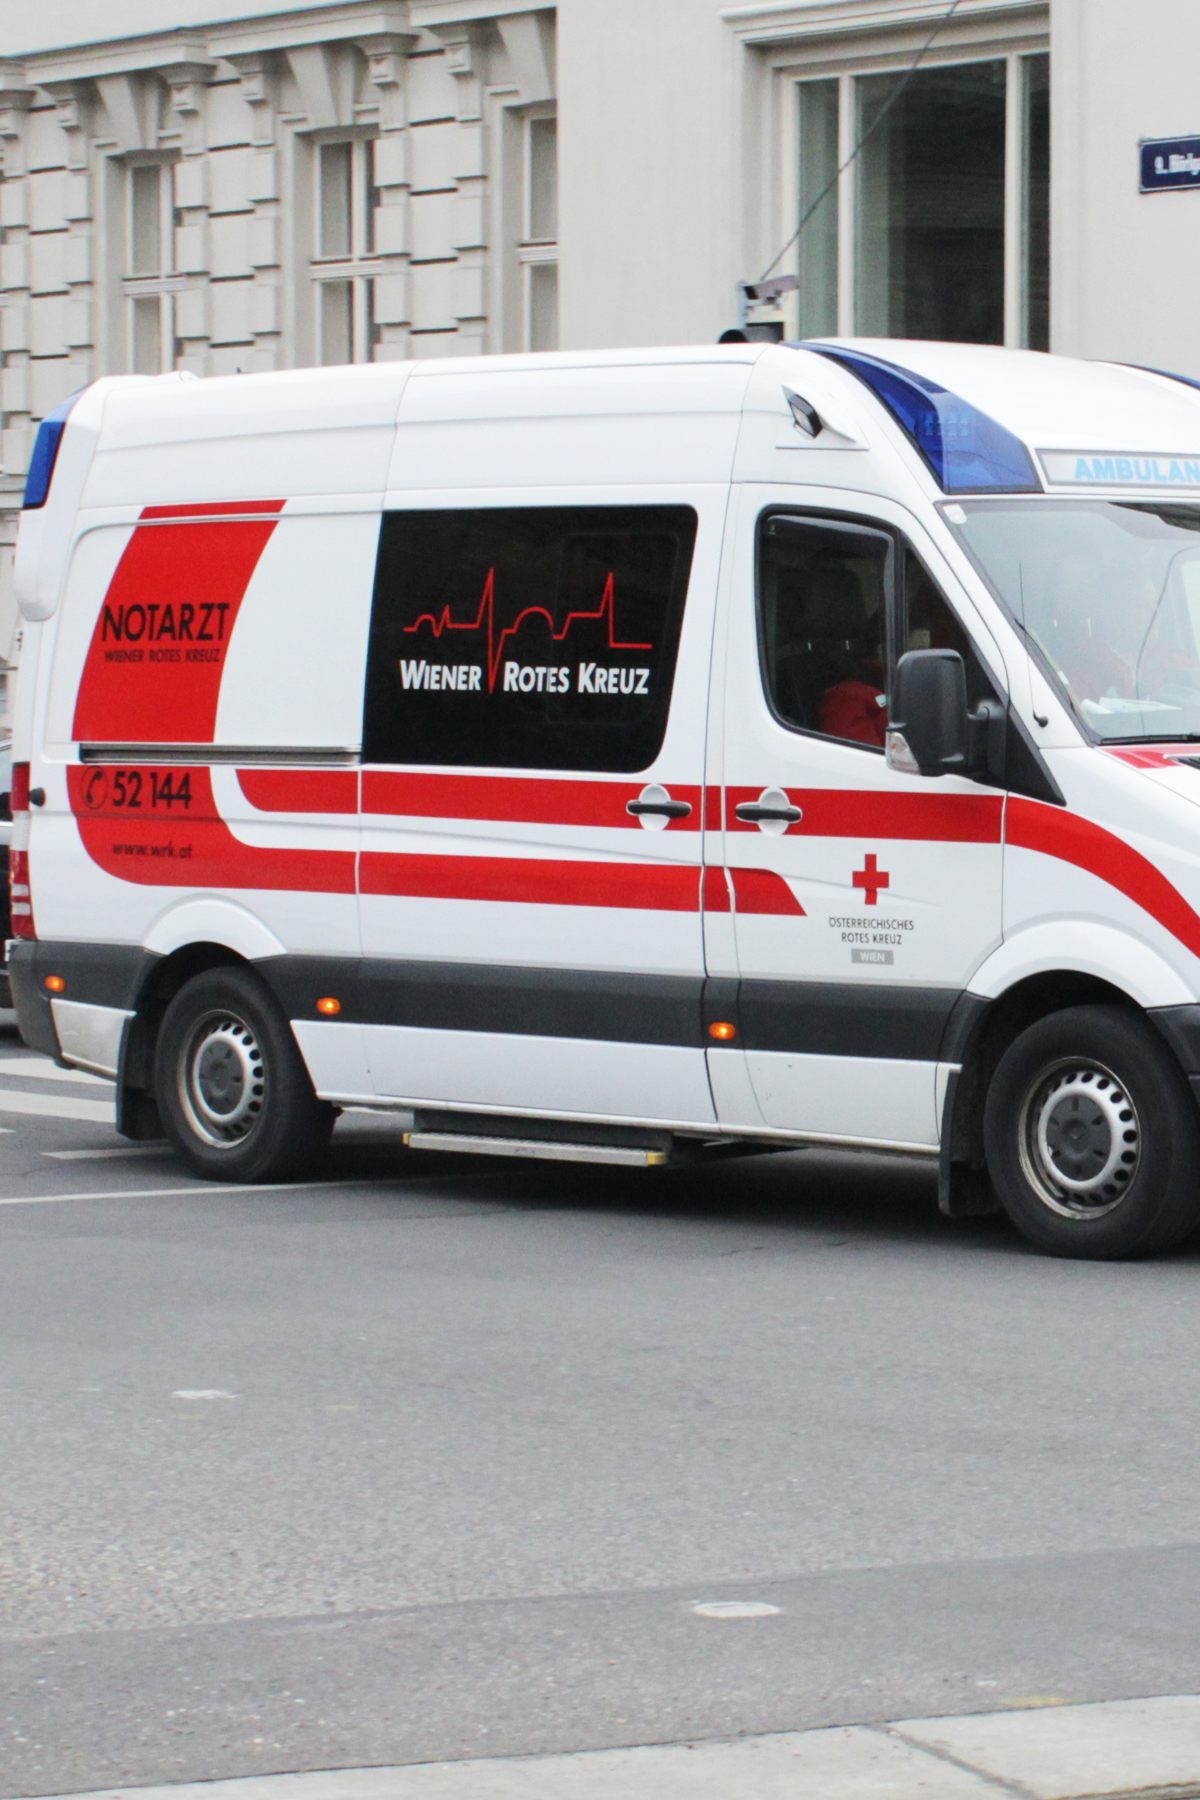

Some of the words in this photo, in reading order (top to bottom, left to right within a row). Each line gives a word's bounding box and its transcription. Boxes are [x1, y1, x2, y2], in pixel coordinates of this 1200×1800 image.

[101, 602, 230, 642] NOTARZT
[105, 649, 144, 663] WIENER
[149, 648, 181, 662] ROTES
[185, 648, 221, 662] KREUZ
[112, 772, 142, 807] 52
[149, 773, 192, 809] 144
[112, 841, 192, 859] www.wrk.at
[841, 932, 869, 944] ROTES
[872, 933, 903, 945] KREUZ
[859, 951, 886, 963] WIEN
